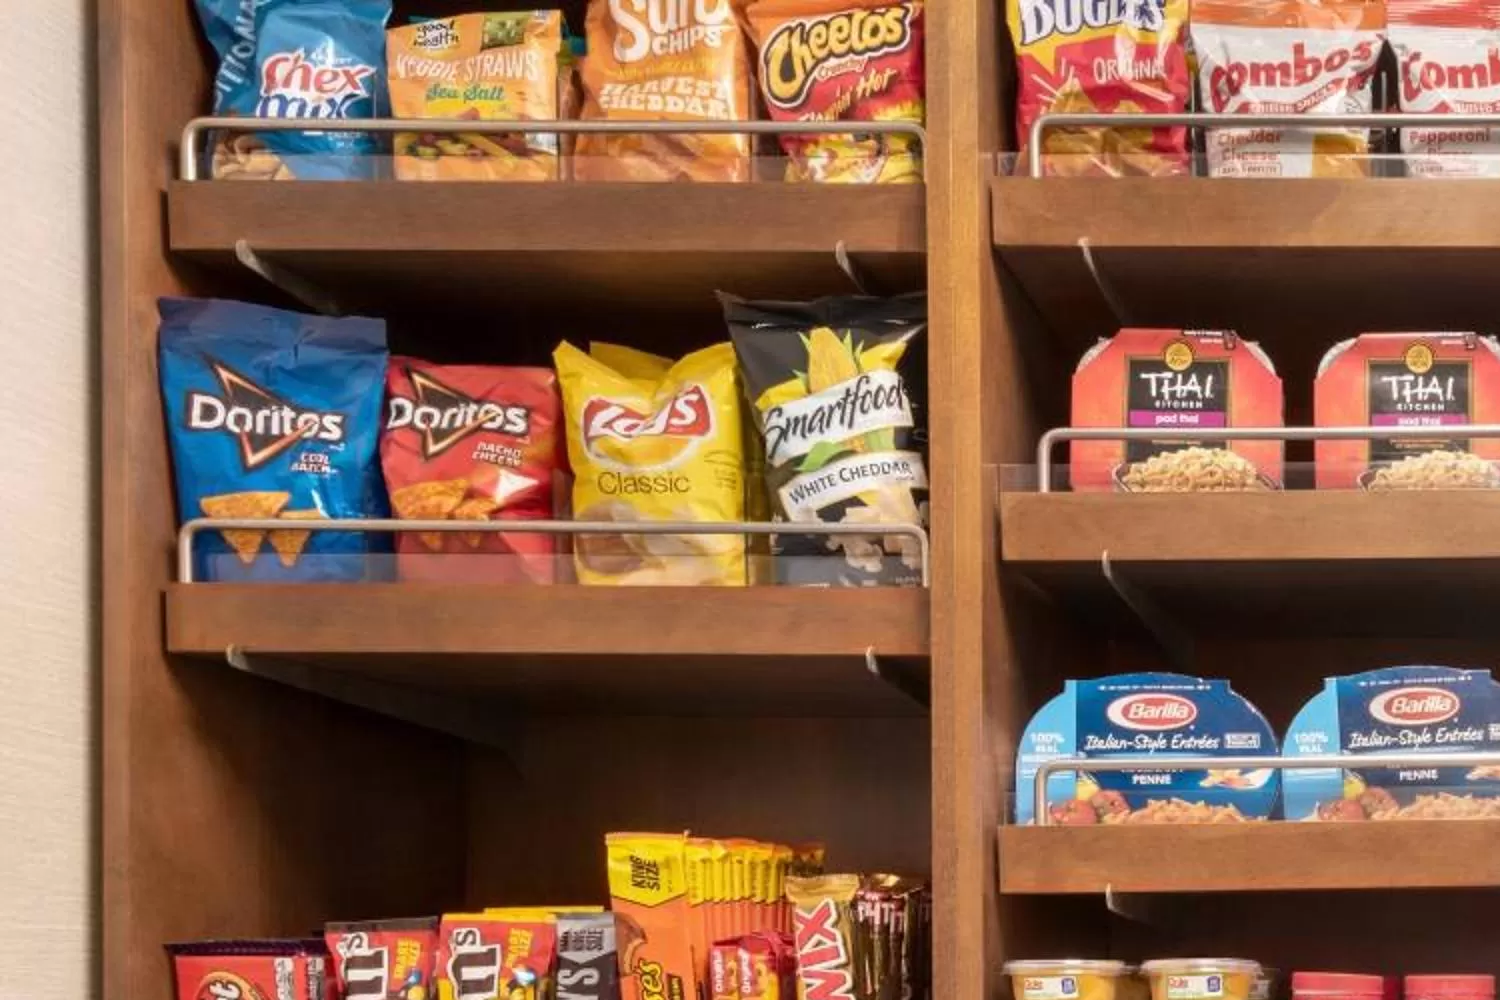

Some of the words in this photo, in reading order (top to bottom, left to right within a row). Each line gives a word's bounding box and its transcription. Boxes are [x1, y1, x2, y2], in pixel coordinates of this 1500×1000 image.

[650, 24, 723, 56] CHIPS
[764, 6, 910, 102] Cheetos
[263, 48, 376, 95] Chex
[464, 51, 540, 82] STRAWS
[1209, 41, 1373, 113] Combos
[426, 85, 458, 102] Sea
[461, 84, 505, 103] Salt
[856, 67, 897, 100] Hot
[1409, 127, 1491, 145] Pepperoni
[1140, 371, 1214, 400] THAI
[1382, 375, 1455, 403] THAI
[191, 393, 345, 442] Doritos
[386, 397, 529, 435] Doritos
[765, 375, 907, 457] Smartfood
[597, 471, 692, 497] Classic
[788, 473, 837, 506] WHITE
[839, 460, 913, 484] CHEDDAR
[1128, 702, 1190, 721] Barilla
[1390, 696, 1453, 715] Barilla
[644, 858, 661, 892] SIZE
